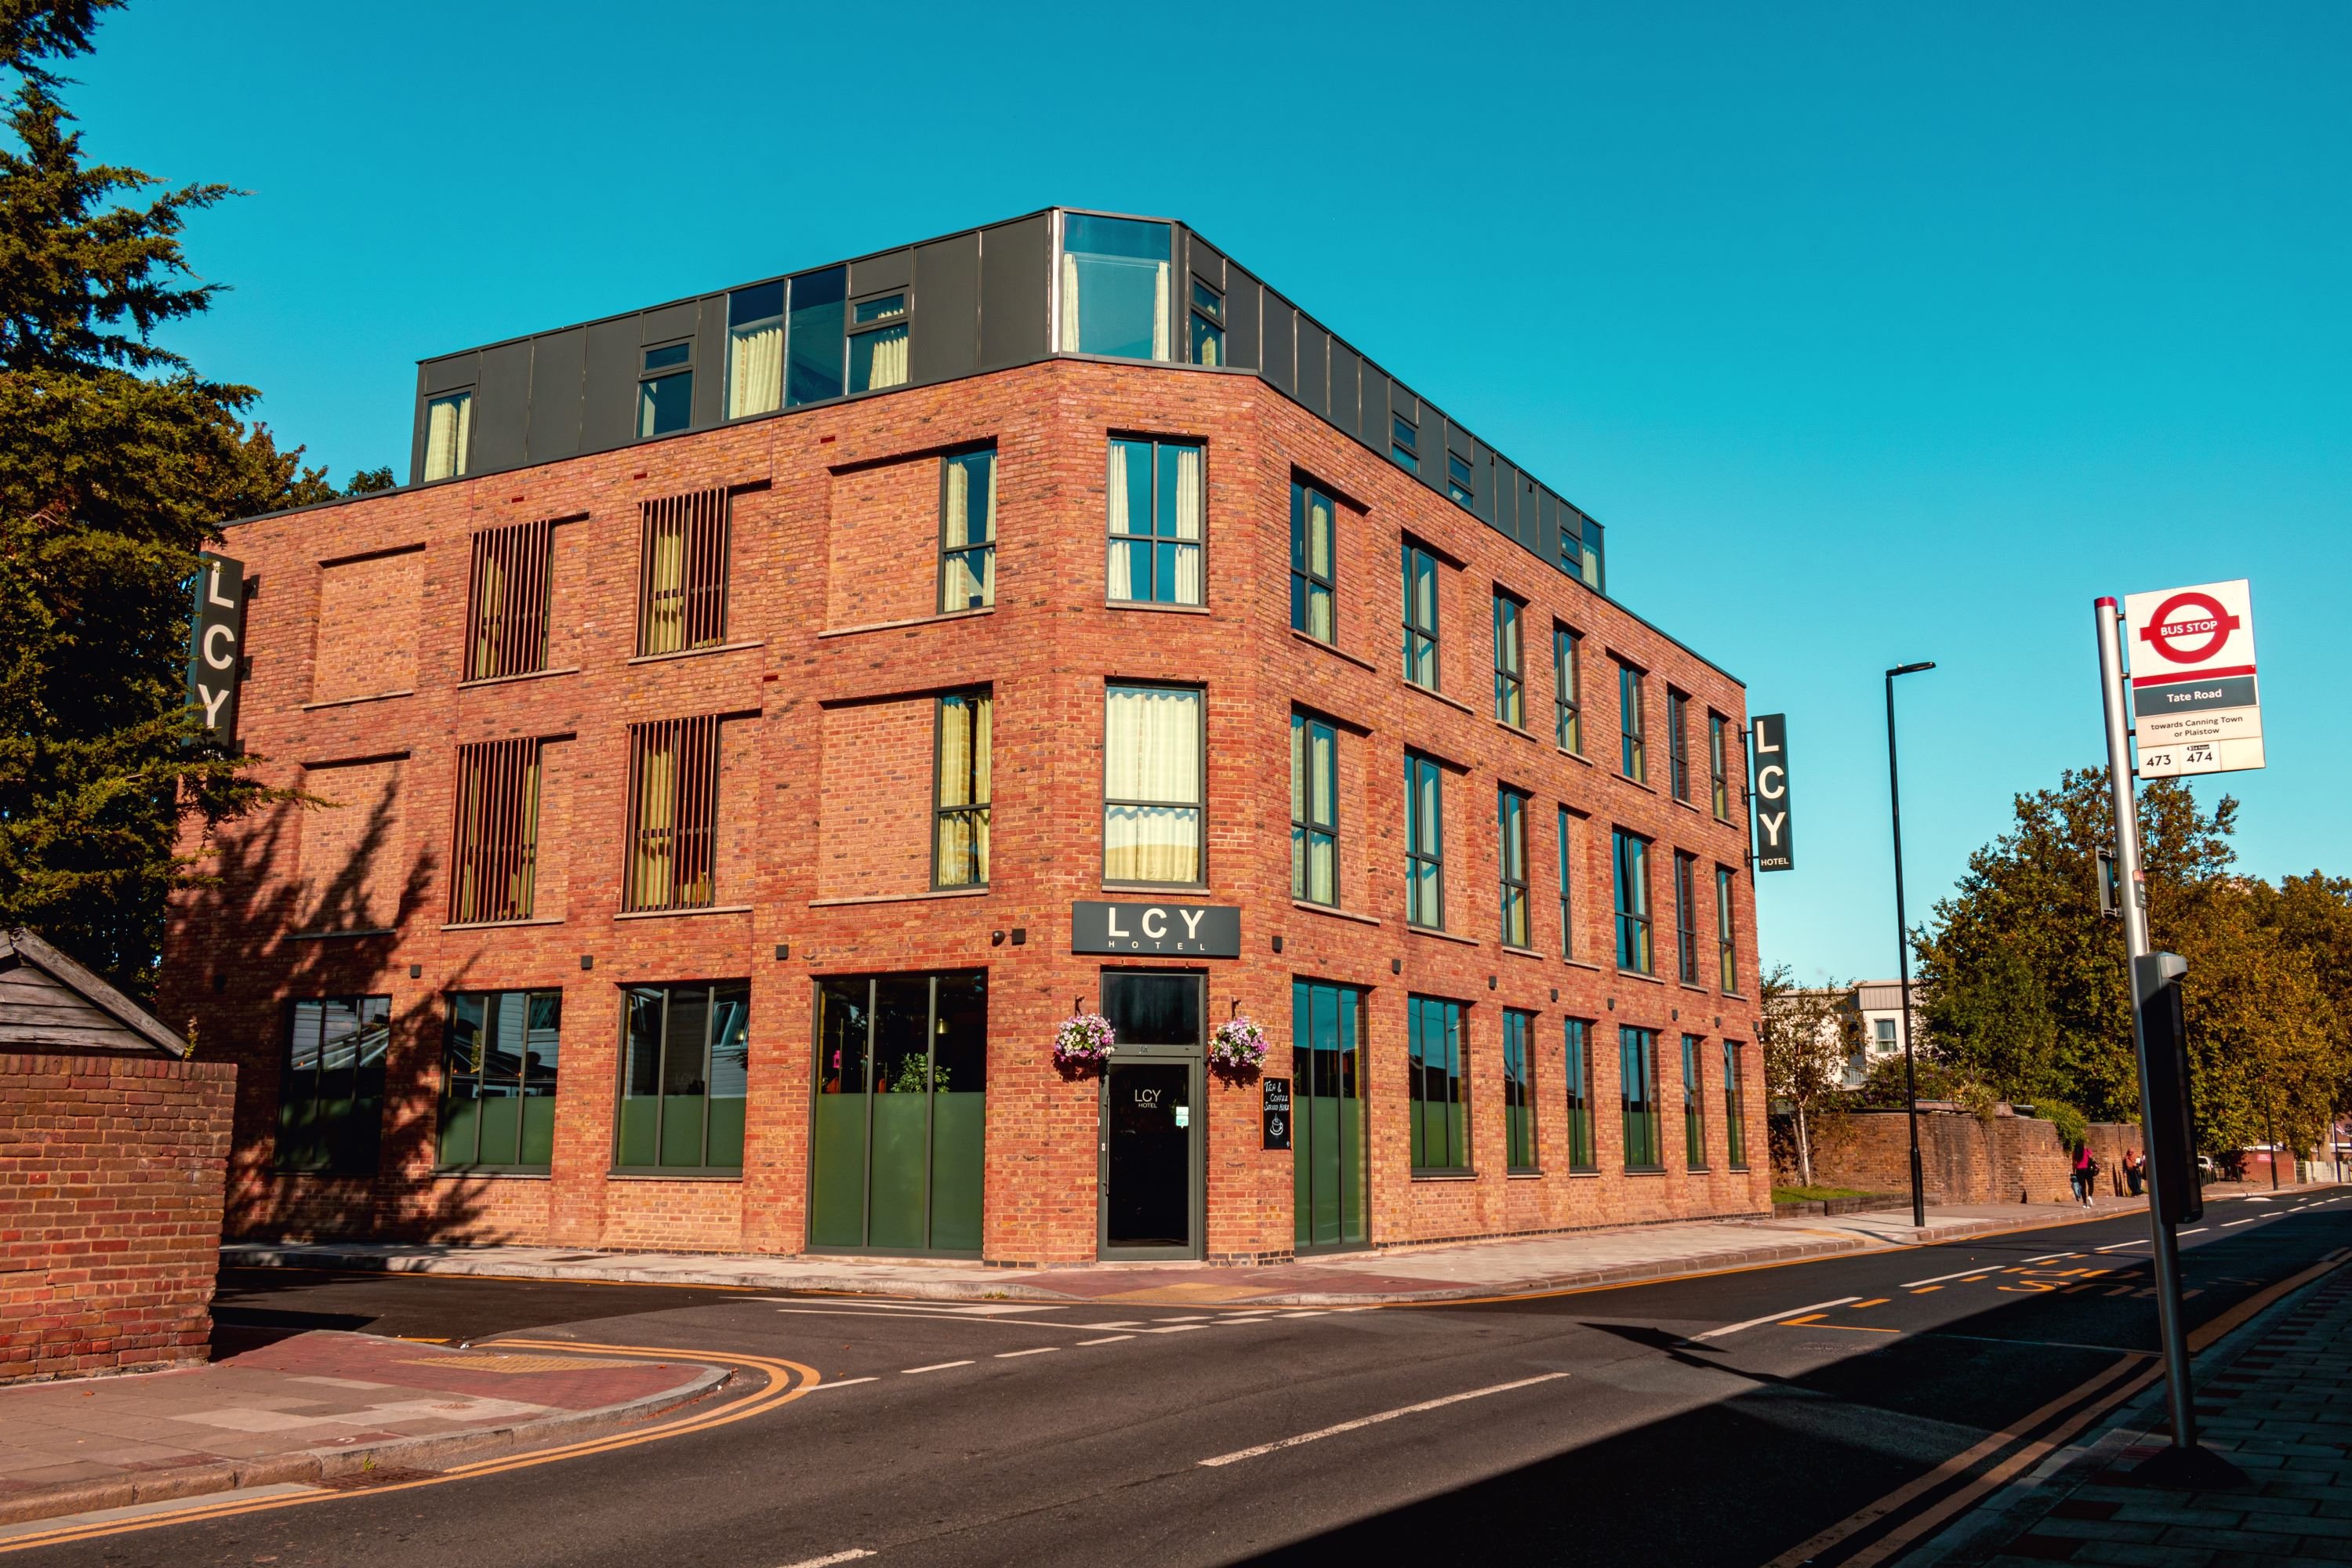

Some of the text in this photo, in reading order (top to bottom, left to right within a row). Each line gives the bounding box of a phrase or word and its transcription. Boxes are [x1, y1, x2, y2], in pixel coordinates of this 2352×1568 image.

[2161, 620, 2218, 636] BUS STOP
[198, 561, 234, 729] LCY
[2166, 688, 2222, 702] Tate Road
[2151, 715, 2243, 731] towards Canning Town
[2184, 728, 2220, 737] Plaistow
[2146, 754, 2172, 767] 473
[2187, 751, 2212, 763] 474
[1756, 720, 1786, 846] LCY
[1109, 907, 1205, 939] LCY
[1109, 941, 1206, 951] HOTEL
[1264, 1080, 1276, 1092] TEA
[1134, 1089, 1161, 1102] LCY
[1270, 1093, 1288, 1102] COFFEE
[2019, 1268, 2268, 1287] SOP
